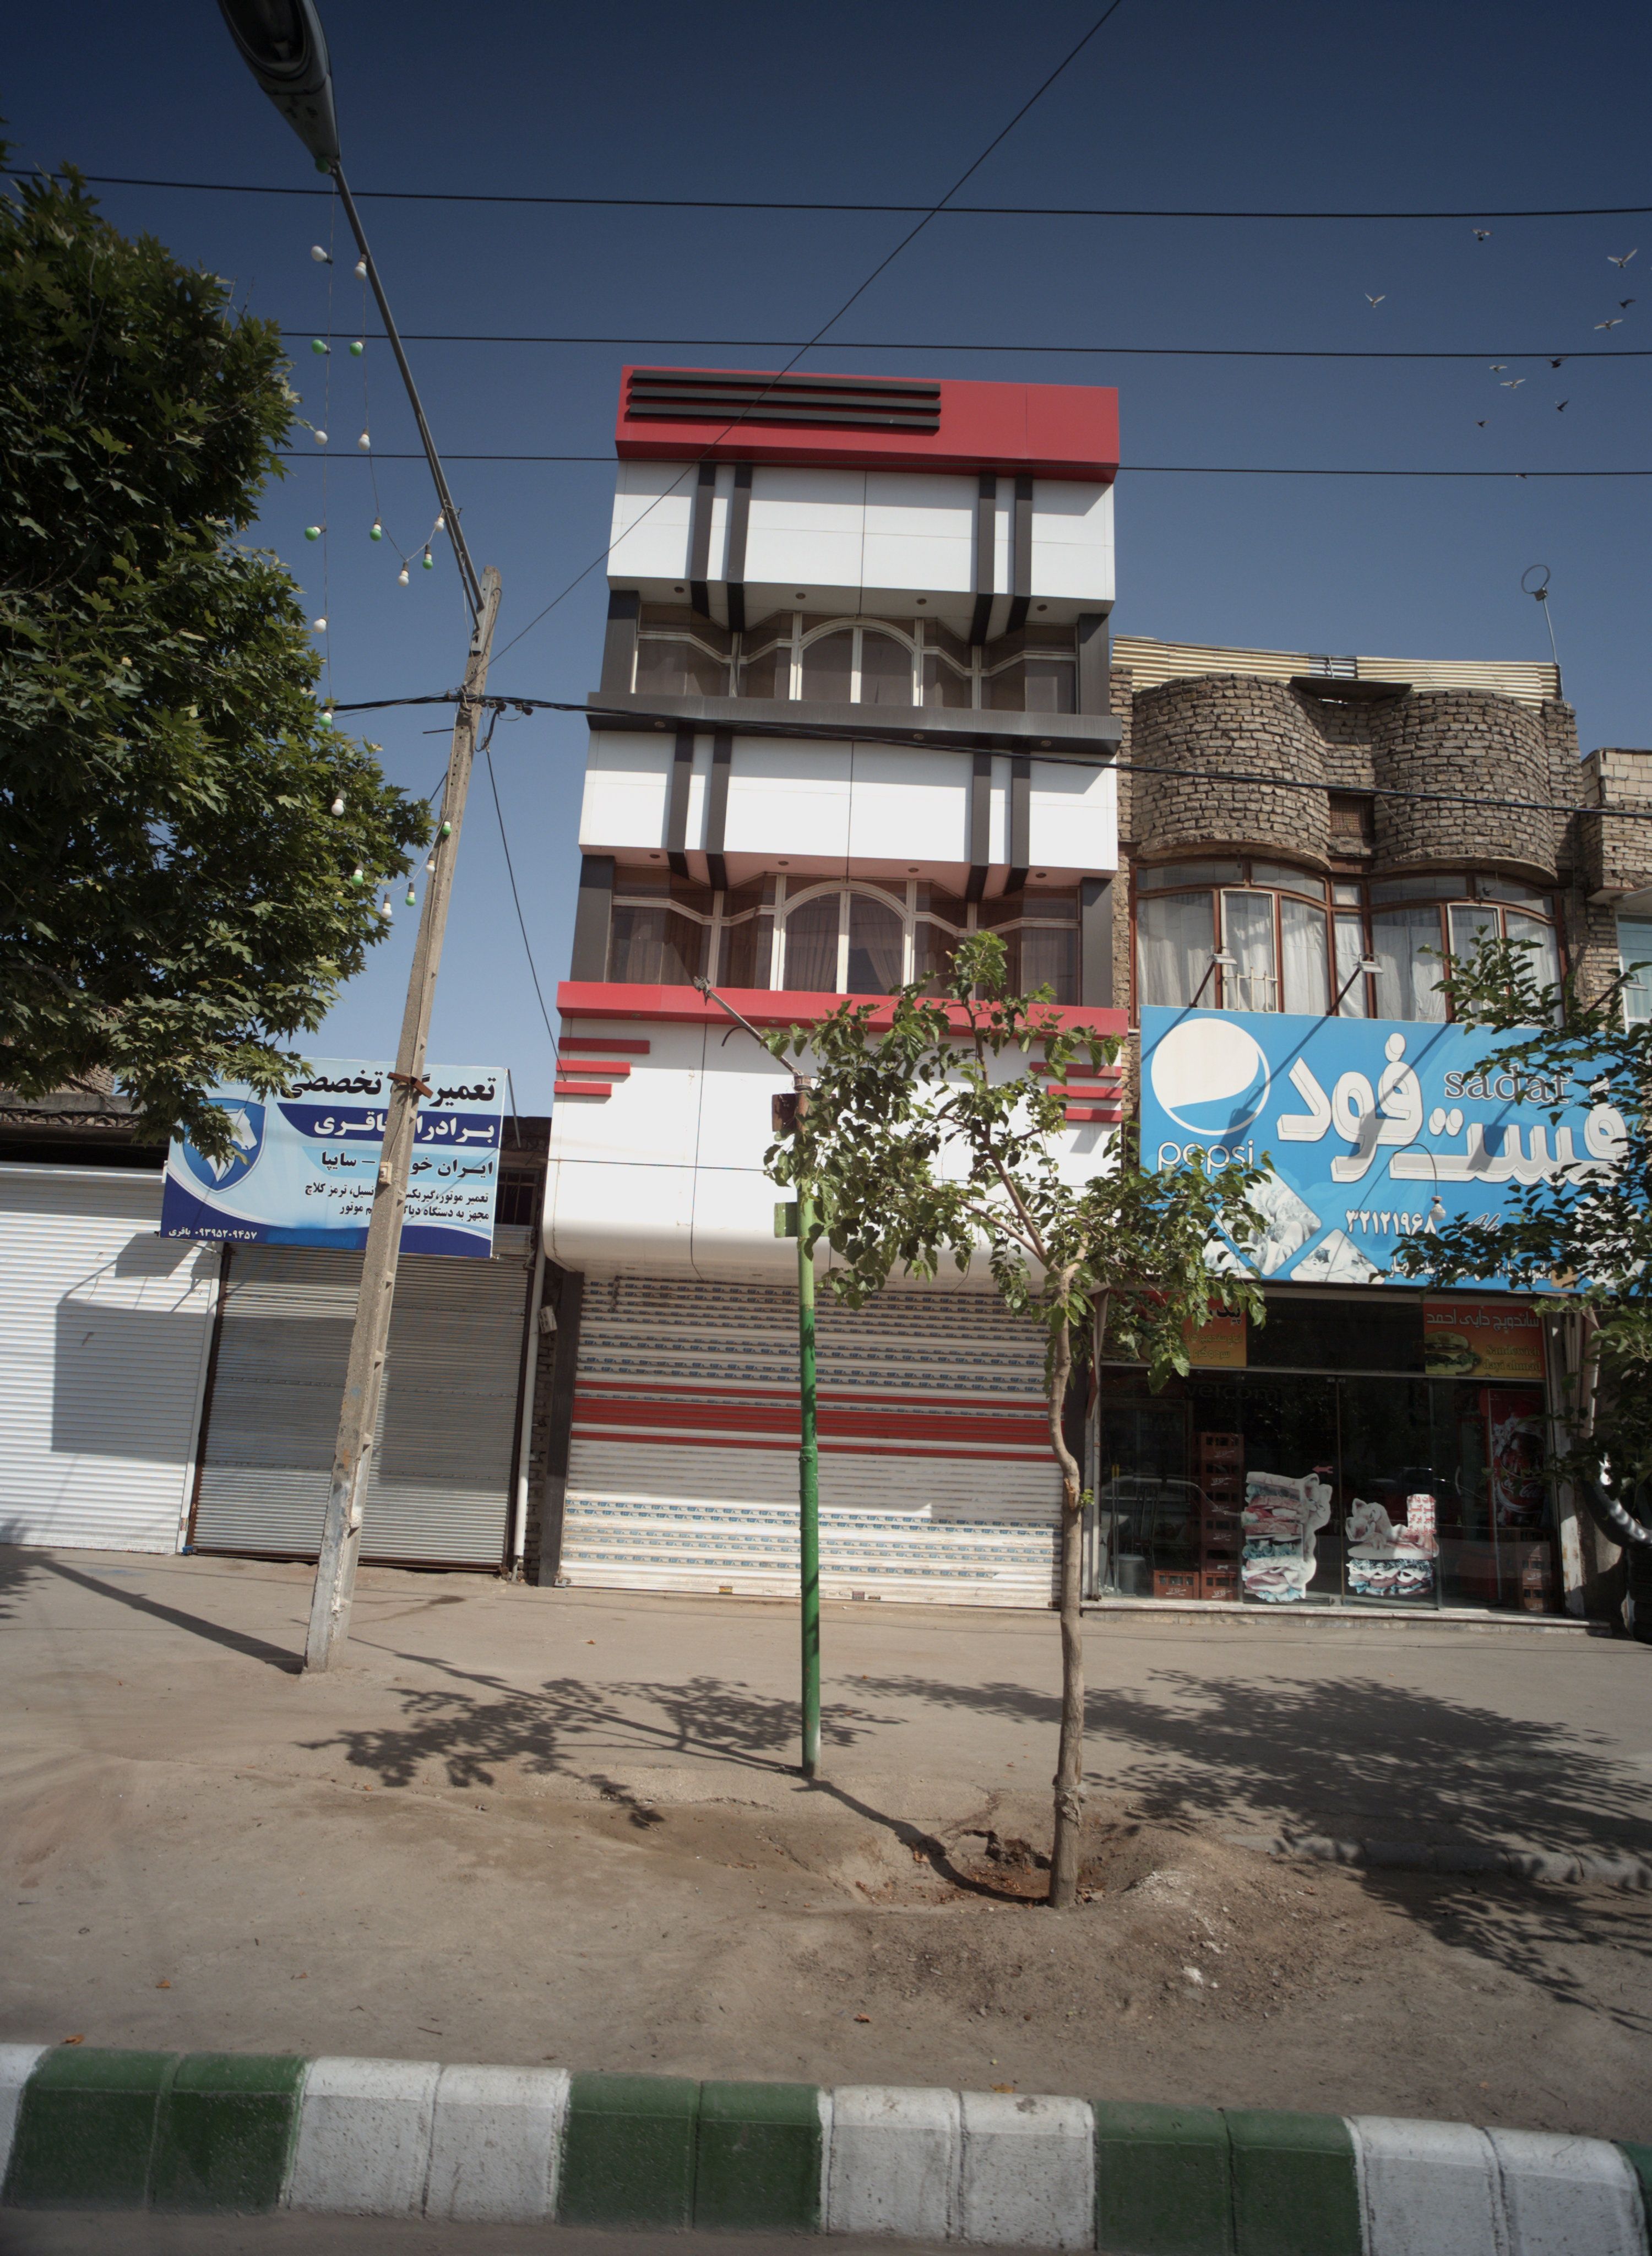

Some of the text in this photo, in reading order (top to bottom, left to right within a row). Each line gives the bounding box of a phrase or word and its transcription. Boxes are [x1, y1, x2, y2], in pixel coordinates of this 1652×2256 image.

[280, 1070, 384, 1098] تخصصی
[1276, 1032, 1629, 1187] فست فود
[314, 1111, 495, 1143] برادرا اقری
[322, 1151, 357, 1171] سایپا
[1157, 1139, 1254, 1175] pepsi
[437, 1158, 493, 1179] ایران
[305, 1182, 326, 1196] کلاچ
[327, 1184, 348, 1198] ترمز
[465, 1191, 489, 1205] تعمیر
[339, 1201, 363, 1215] موتور
[423, 1205, 453, 1217] دستگاه
[455, 1208, 464, 1218] به
[466, 1209, 490, 1222] مجهز
[1345, 1208, 1437, 1236] ۳۲۱۲۱۹۶۸
[168, 1227, 258, 1240] ۰۹۳۹۵۲۰۹۴۵۷ باقری
[1426, 1308, 1457, 1325] احمد
[1493, 1311, 1540, 1332] ساندویچ
